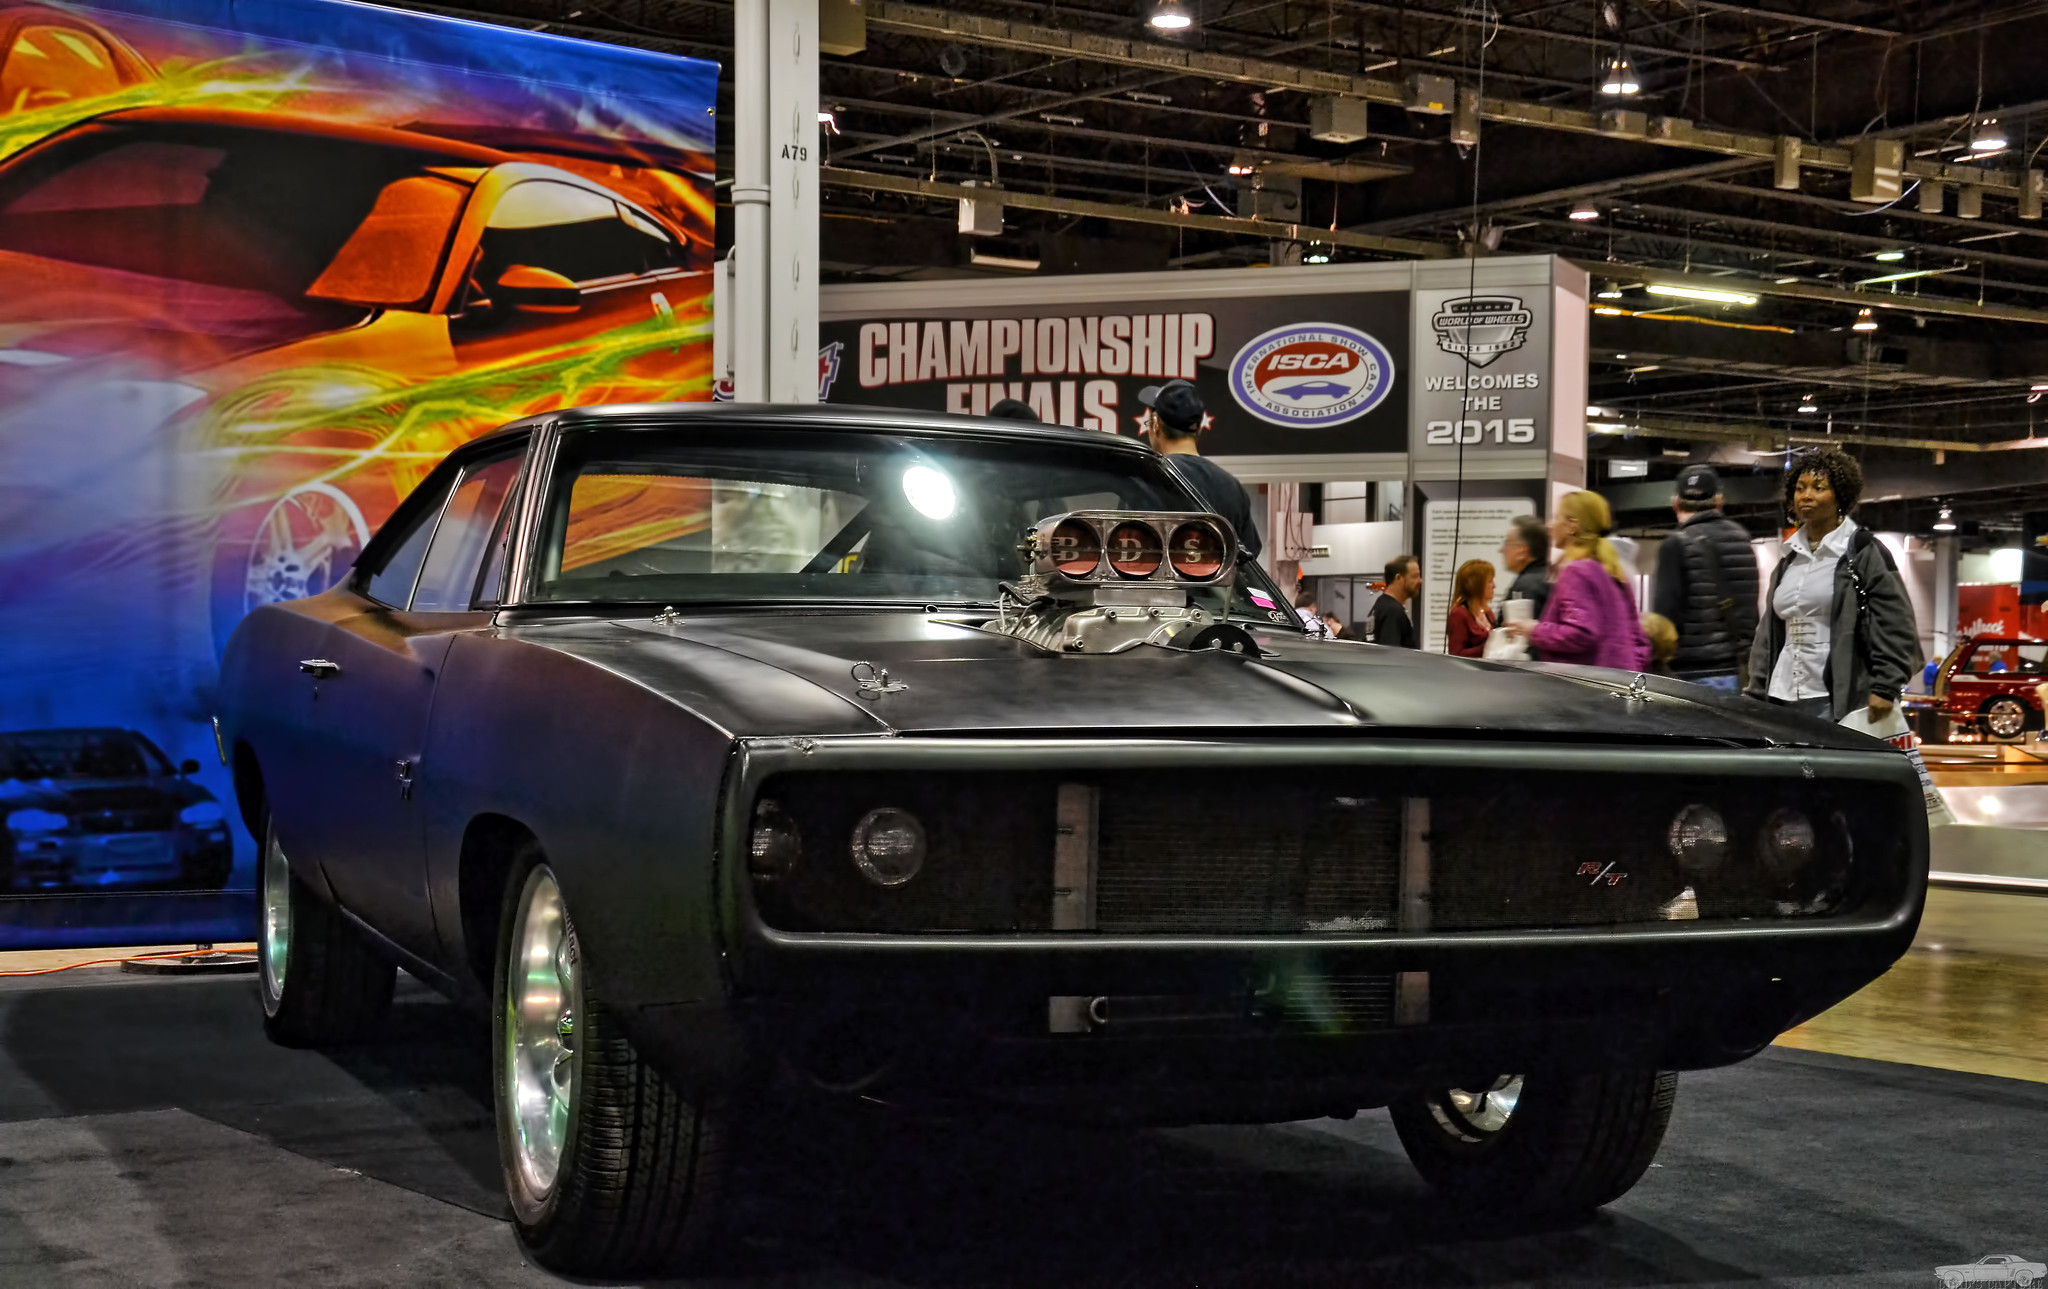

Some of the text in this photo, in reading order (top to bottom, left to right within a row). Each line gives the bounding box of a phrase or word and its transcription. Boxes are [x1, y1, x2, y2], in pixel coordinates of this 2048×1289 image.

[781, 144, 807, 161] A79
[1439, 316, 1473, 326] WORLD
[1485, 314, 1525, 325] WHEELS
[859, 313, 1214, 388] CHAMPIONSHIP
[1447, 343, 1480, 352] SINCE
[1267, 352, 1350, 370] ISCA
[1245, 334, 1377, 417] INTERNATIONAL SHOW CAR ASSOCIATION
[1425, 373, 1539, 391] WELCOMES
[1461, 396, 1502, 411] THE
[1427, 418, 1535, 444] 2015
[1576, 861, 1628, 886] R/T
